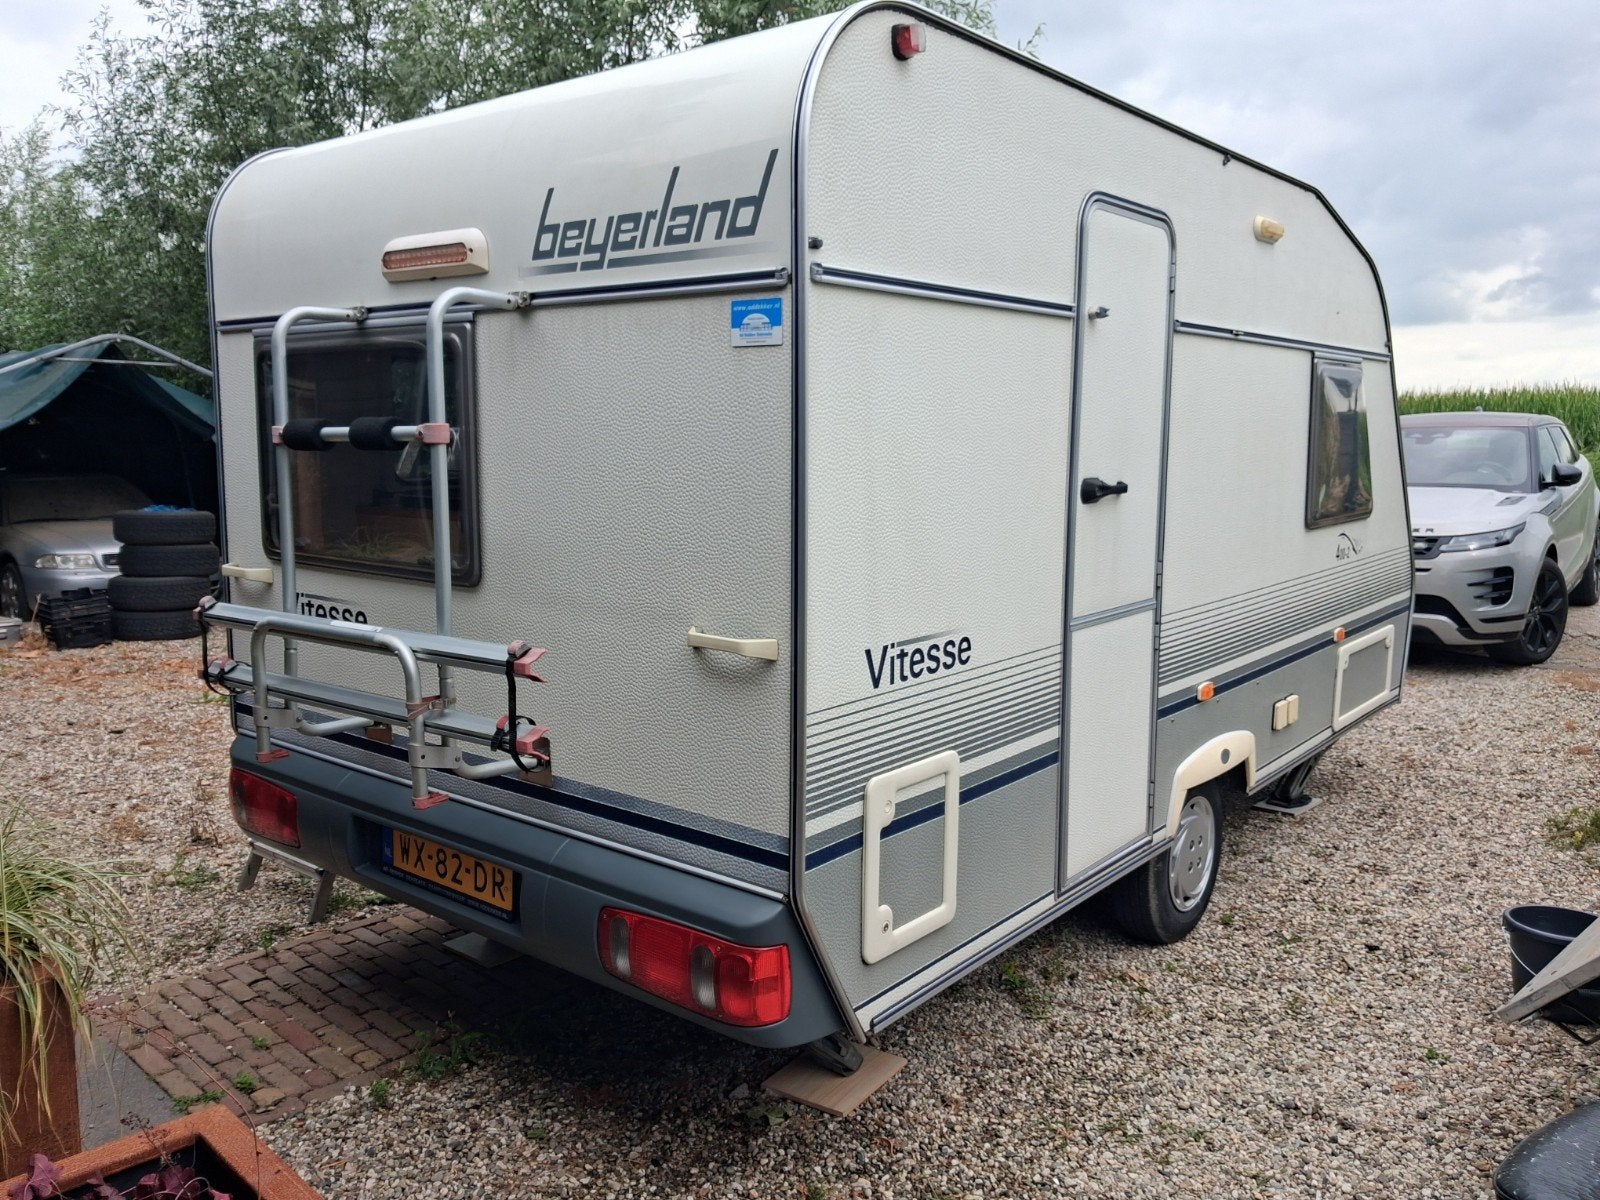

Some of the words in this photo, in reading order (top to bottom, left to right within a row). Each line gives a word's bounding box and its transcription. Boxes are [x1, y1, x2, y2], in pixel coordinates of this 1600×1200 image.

[532, 148, 779, 272] beyerland
[296, 592, 368, 624] itesse
[864, 636, 972, 690] Vitesse
[400, 833, 505, 902] WX-82-DR
